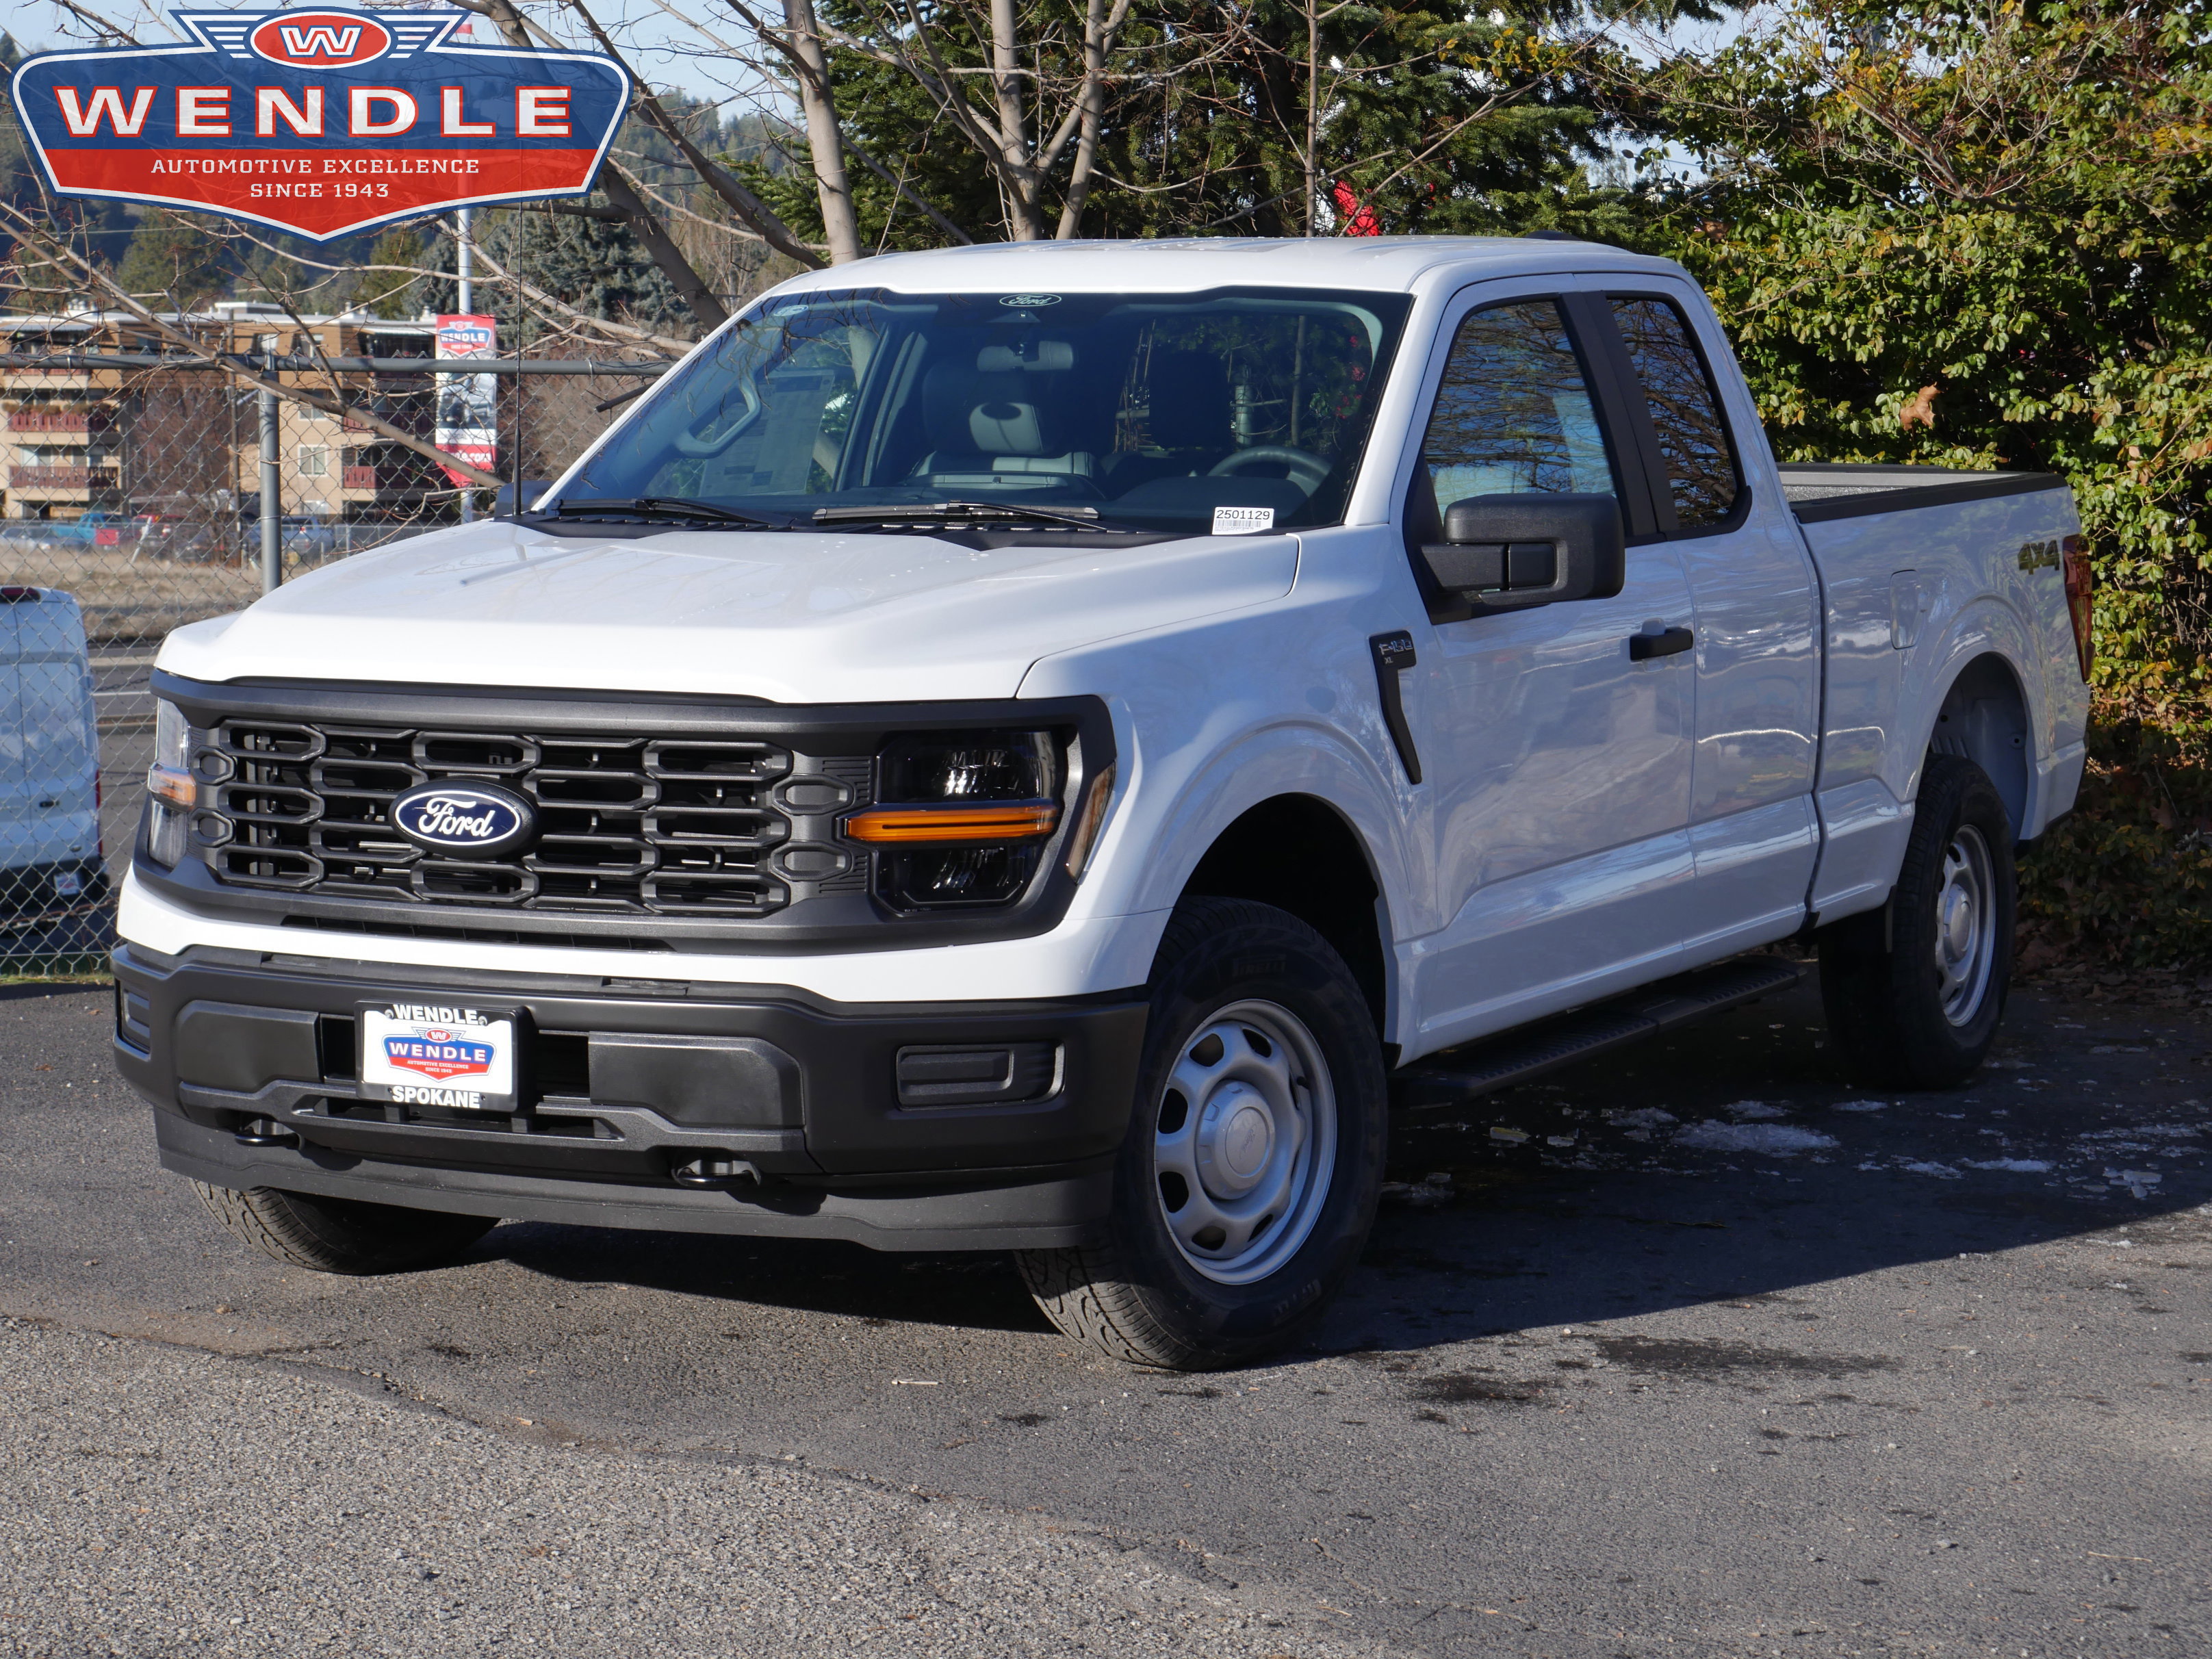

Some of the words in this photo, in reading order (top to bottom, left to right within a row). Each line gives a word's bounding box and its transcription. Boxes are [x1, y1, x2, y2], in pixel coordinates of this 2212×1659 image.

[1007, 295, 1052, 305] Ford
[440, 333, 485, 342] WENDLE
[1216, 510, 1270, 520] 2501129
[418, 797, 496, 837] Ford
[393, 1004, 480, 1025] WENDLE
[389, 1042, 486, 1062] WENDLE
[392, 1086, 480, 1109] SPOKANE
